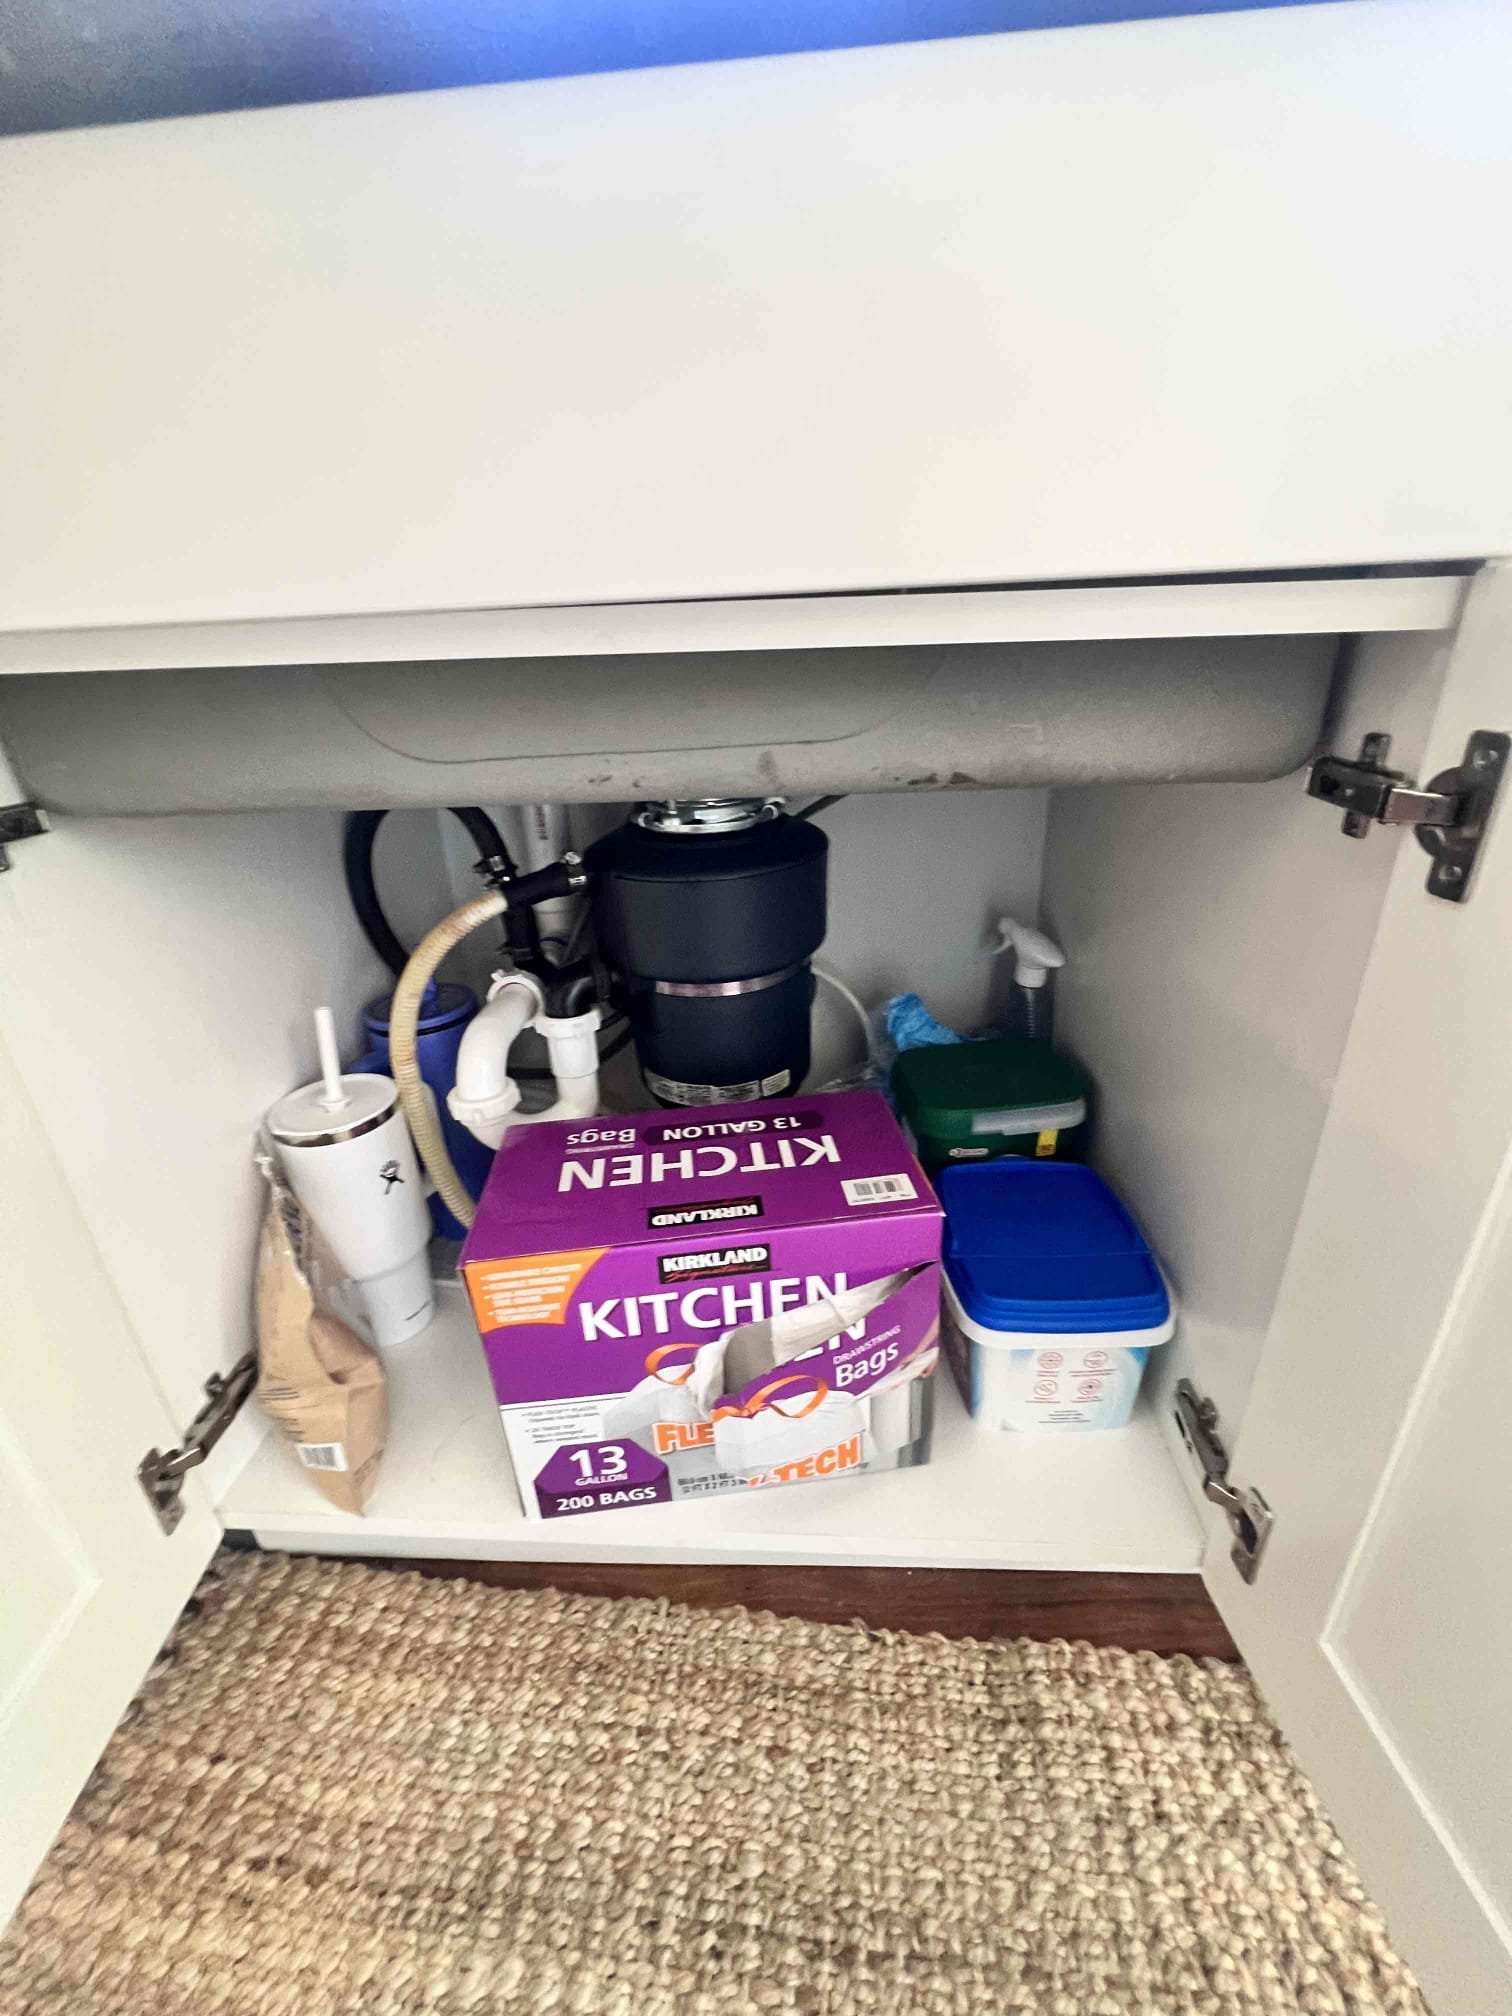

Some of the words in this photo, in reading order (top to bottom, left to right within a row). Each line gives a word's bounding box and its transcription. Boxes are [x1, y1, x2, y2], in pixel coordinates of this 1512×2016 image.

[662, 1119, 766, 1141] GALLON
[772, 1115, 802, 1130] 13
[567, 1127, 637, 1146] Bags
[557, 1134, 842, 1193] KITCHEN
[651, 1204, 758, 1227] KIRKLAND
[662, 1246, 768, 1273] KIRKLAND
[834, 1342, 900, 1388] Bags
[568, 1445, 628, 1478] 13
[575, 1472, 629, 1486] GALLON
[556, 1494, 595, 1511] 200
[599, 1486, 657, 1506] BAGS
